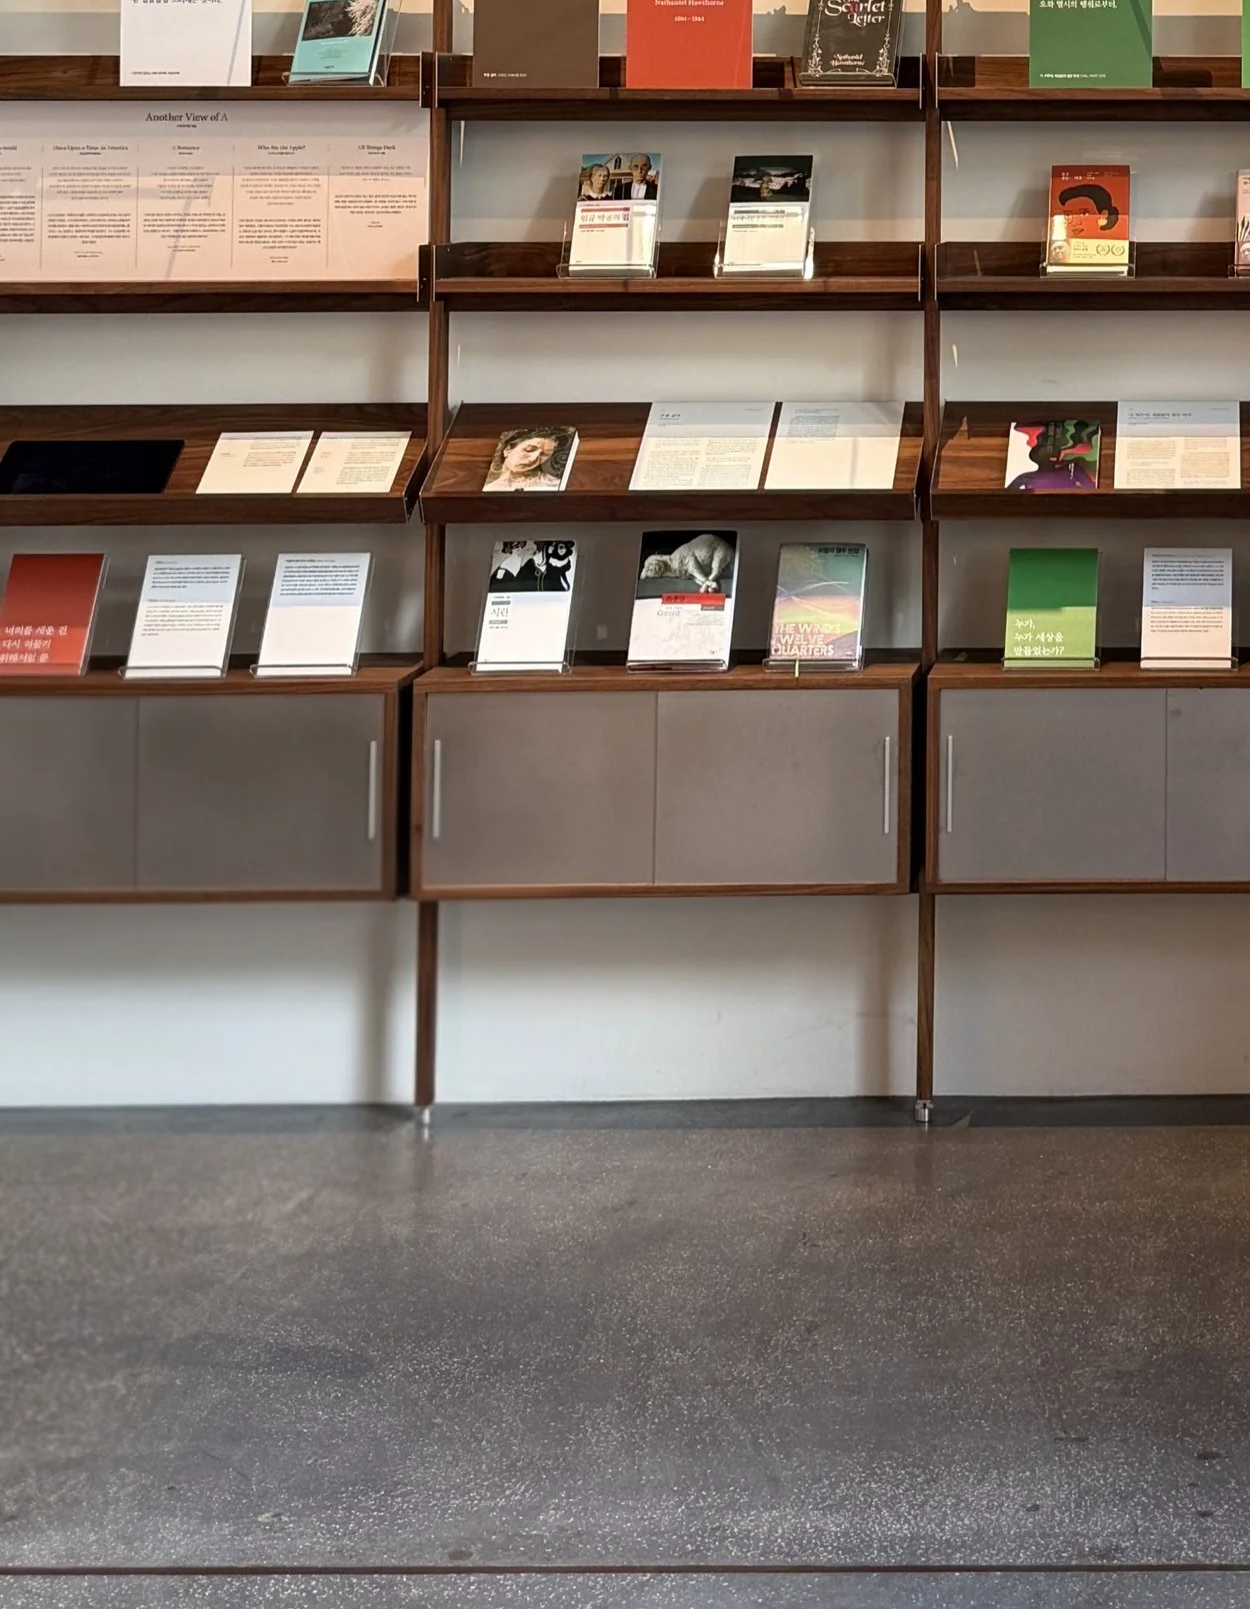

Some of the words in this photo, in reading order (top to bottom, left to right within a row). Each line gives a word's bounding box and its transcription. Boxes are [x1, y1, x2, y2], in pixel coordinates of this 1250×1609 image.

[847, 12, 885, 27] Letter
[145, 112, 184, 122] Another
[184, 112, 209, 122] View
[210, 111, 220, 122] of
[220, 112, 228, 122] A
[774, 623, 795, 633] THE
[1014, 631, 1032, 642] 누가
[771, 644, 835, 657] QUARTERS
